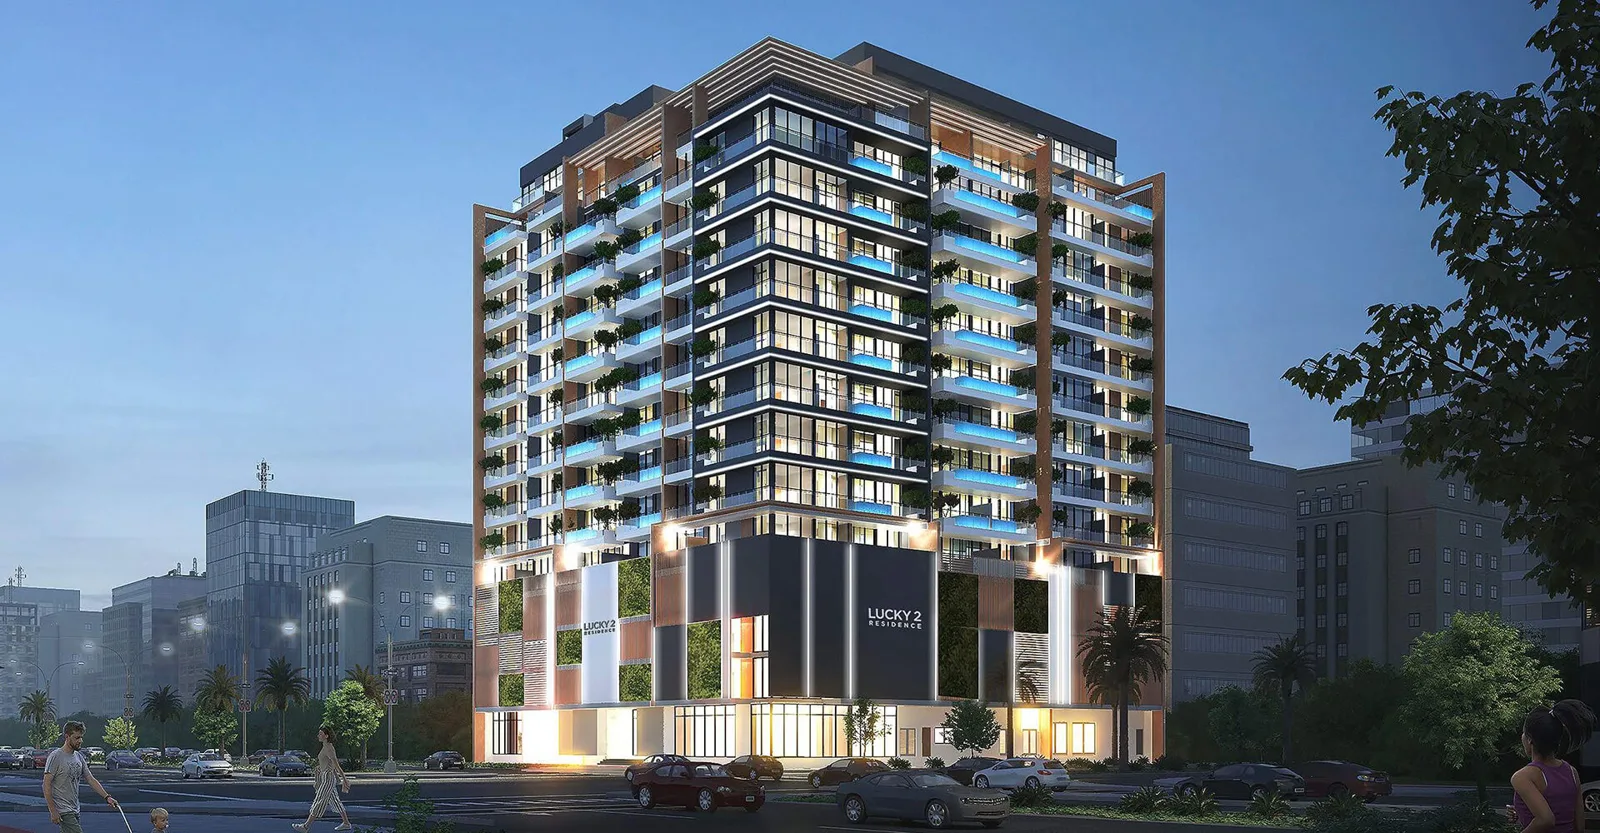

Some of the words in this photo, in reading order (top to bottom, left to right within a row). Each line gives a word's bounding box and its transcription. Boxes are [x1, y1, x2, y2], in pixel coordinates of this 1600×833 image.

[868, 607, 911, 621] LUCKY
[913, 610, 922, 622] 2
[583, 620, 610, 630] LUCKY
[868, 620, 922, 630] RESIDENCE
[583, 628, 616, 636] RESIDENCE
